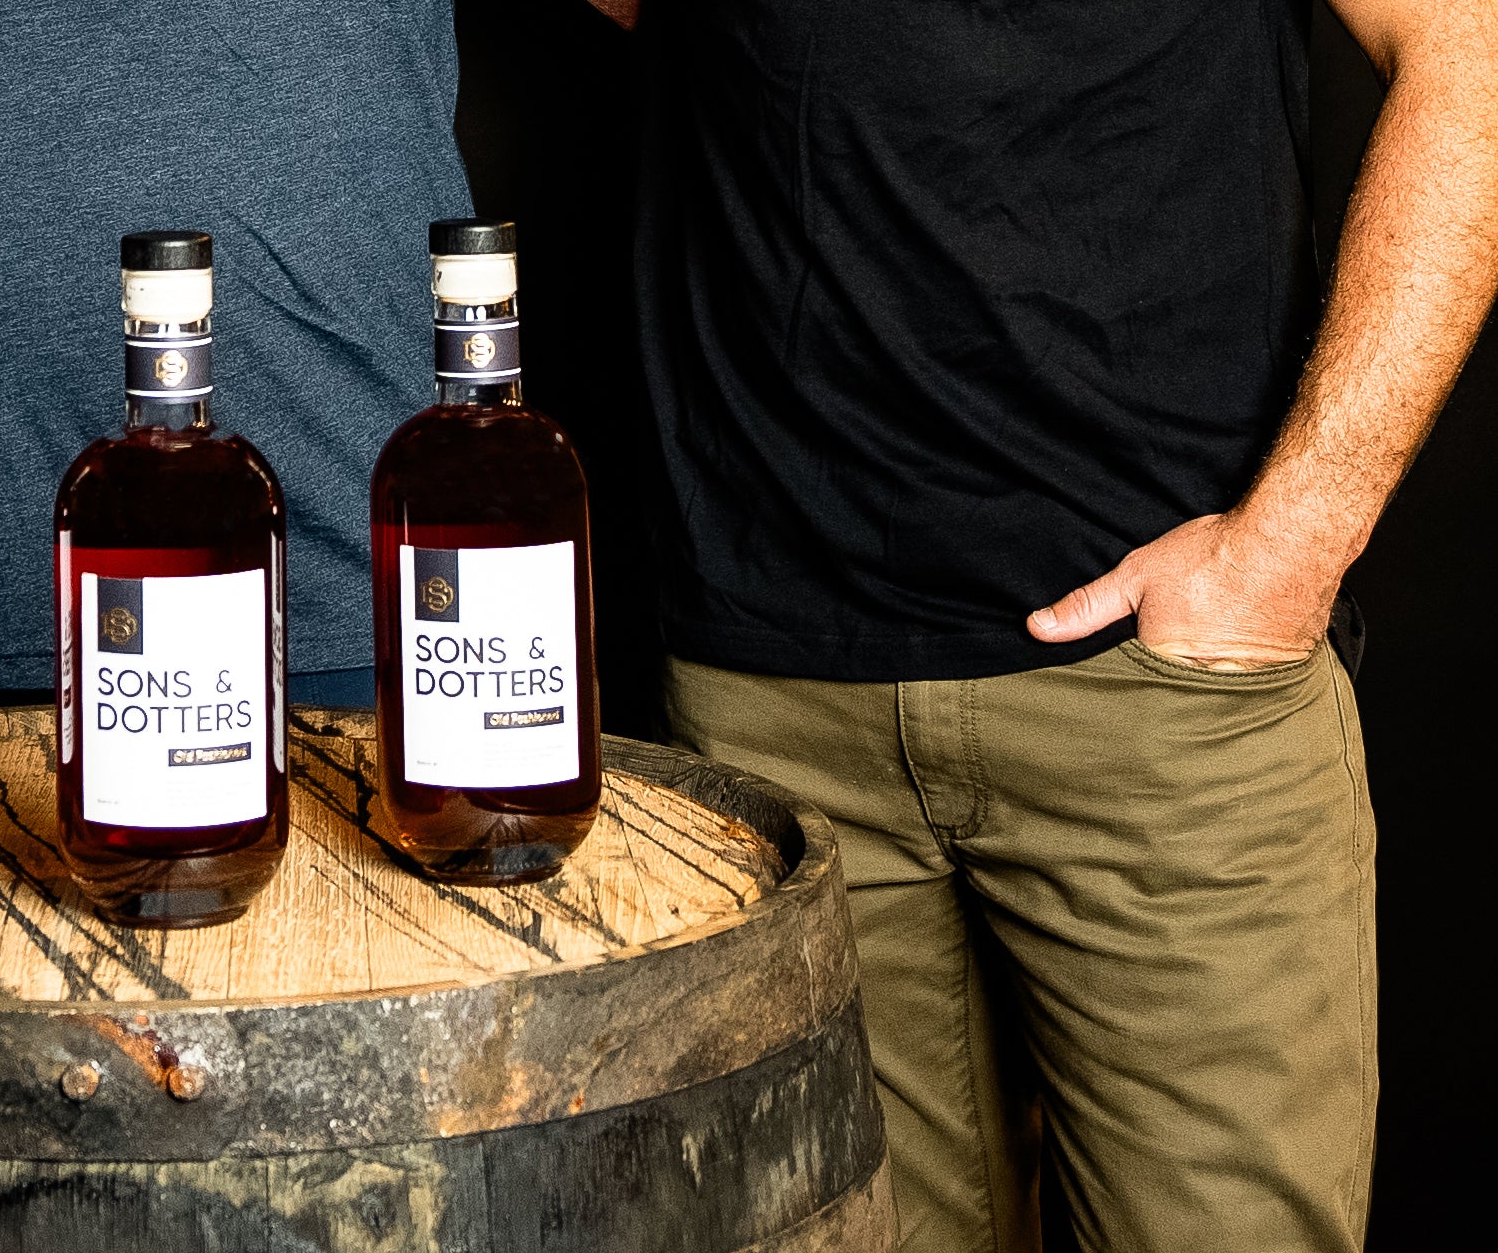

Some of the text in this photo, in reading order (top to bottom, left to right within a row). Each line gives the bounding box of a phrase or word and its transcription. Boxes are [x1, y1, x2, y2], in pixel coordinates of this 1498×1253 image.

[415, 634, 545, 664] SONS &
[97, 667, 232, 698] SONS &
[415, 666, 564, 698] DOTTERS
[97, 700, 252, 733] DOTTERS
